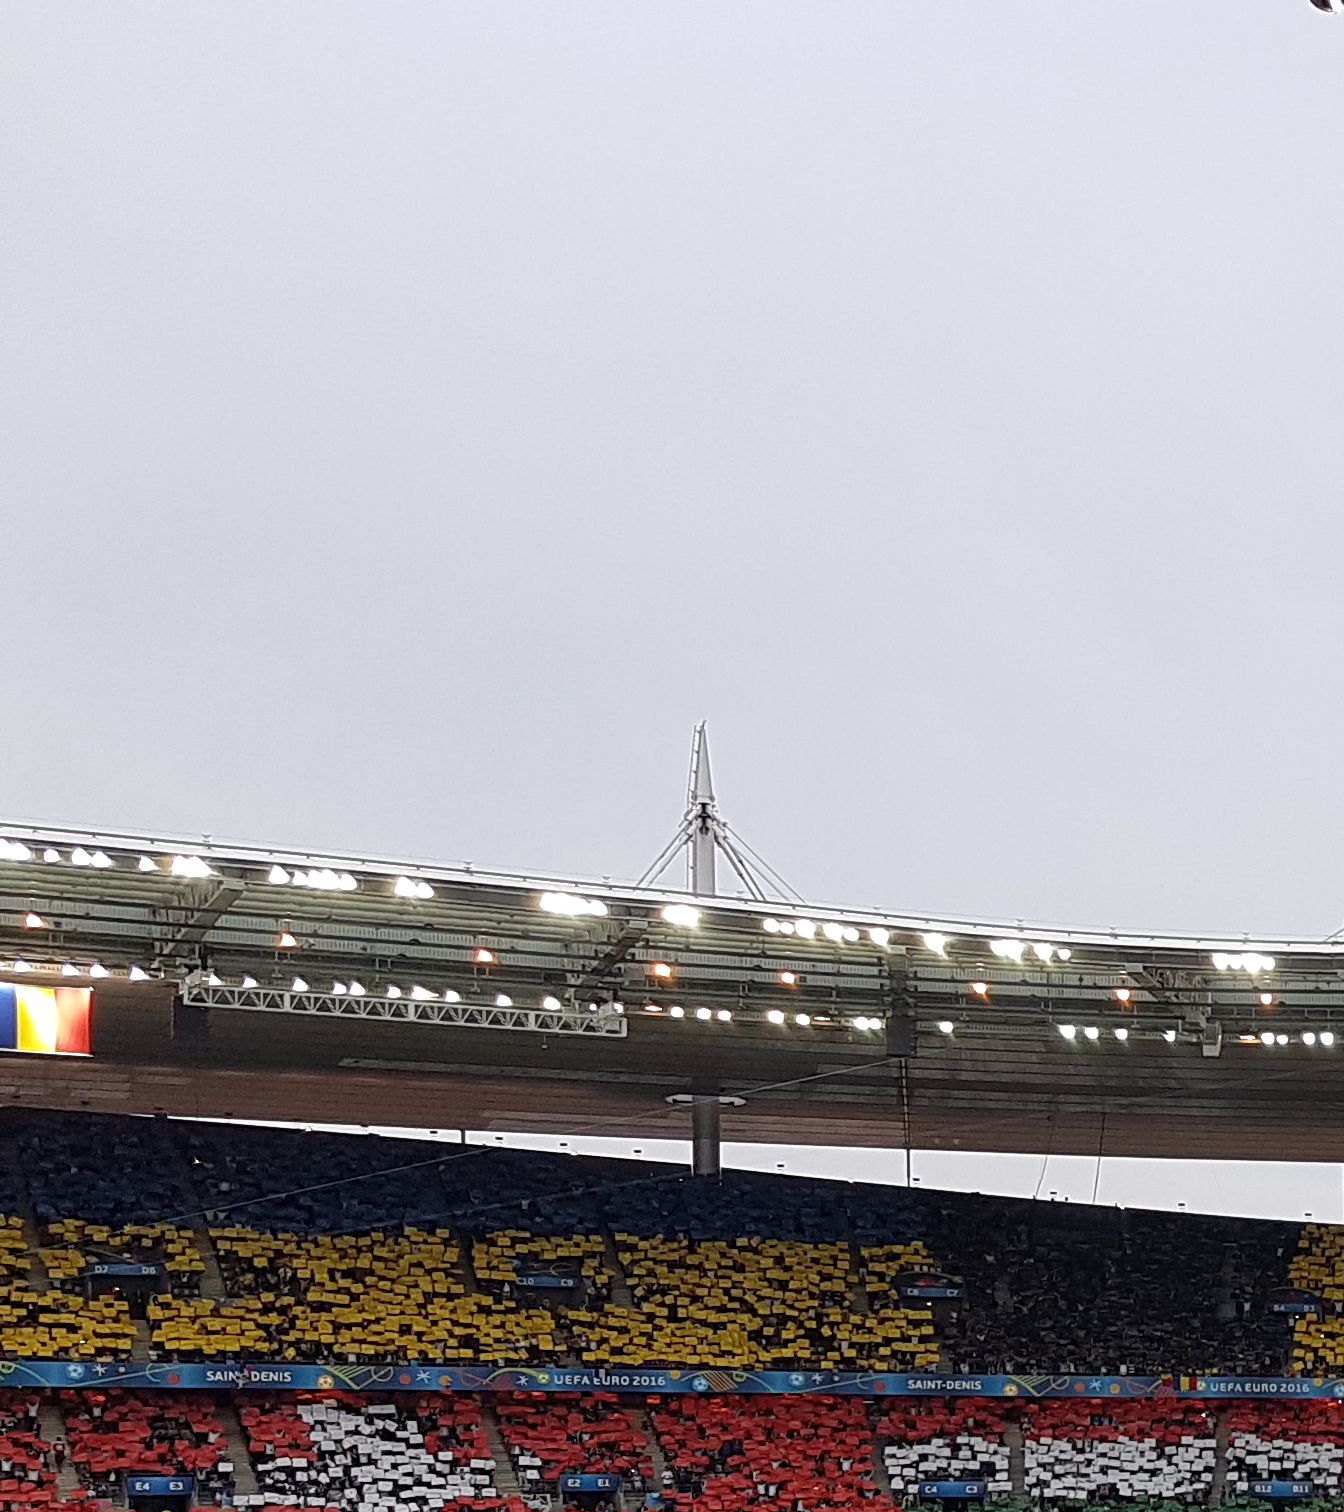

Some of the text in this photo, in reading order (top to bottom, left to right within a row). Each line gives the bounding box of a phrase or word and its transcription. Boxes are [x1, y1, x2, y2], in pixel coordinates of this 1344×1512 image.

[554, 1374, 590, 1386] UEFA
[632, 1375, 666, 1386] 2016
[907, 1379, 982, 1391] SAINT-DENIS
[1210, 1382, 1310, 1394] UEFA EURO 2016
